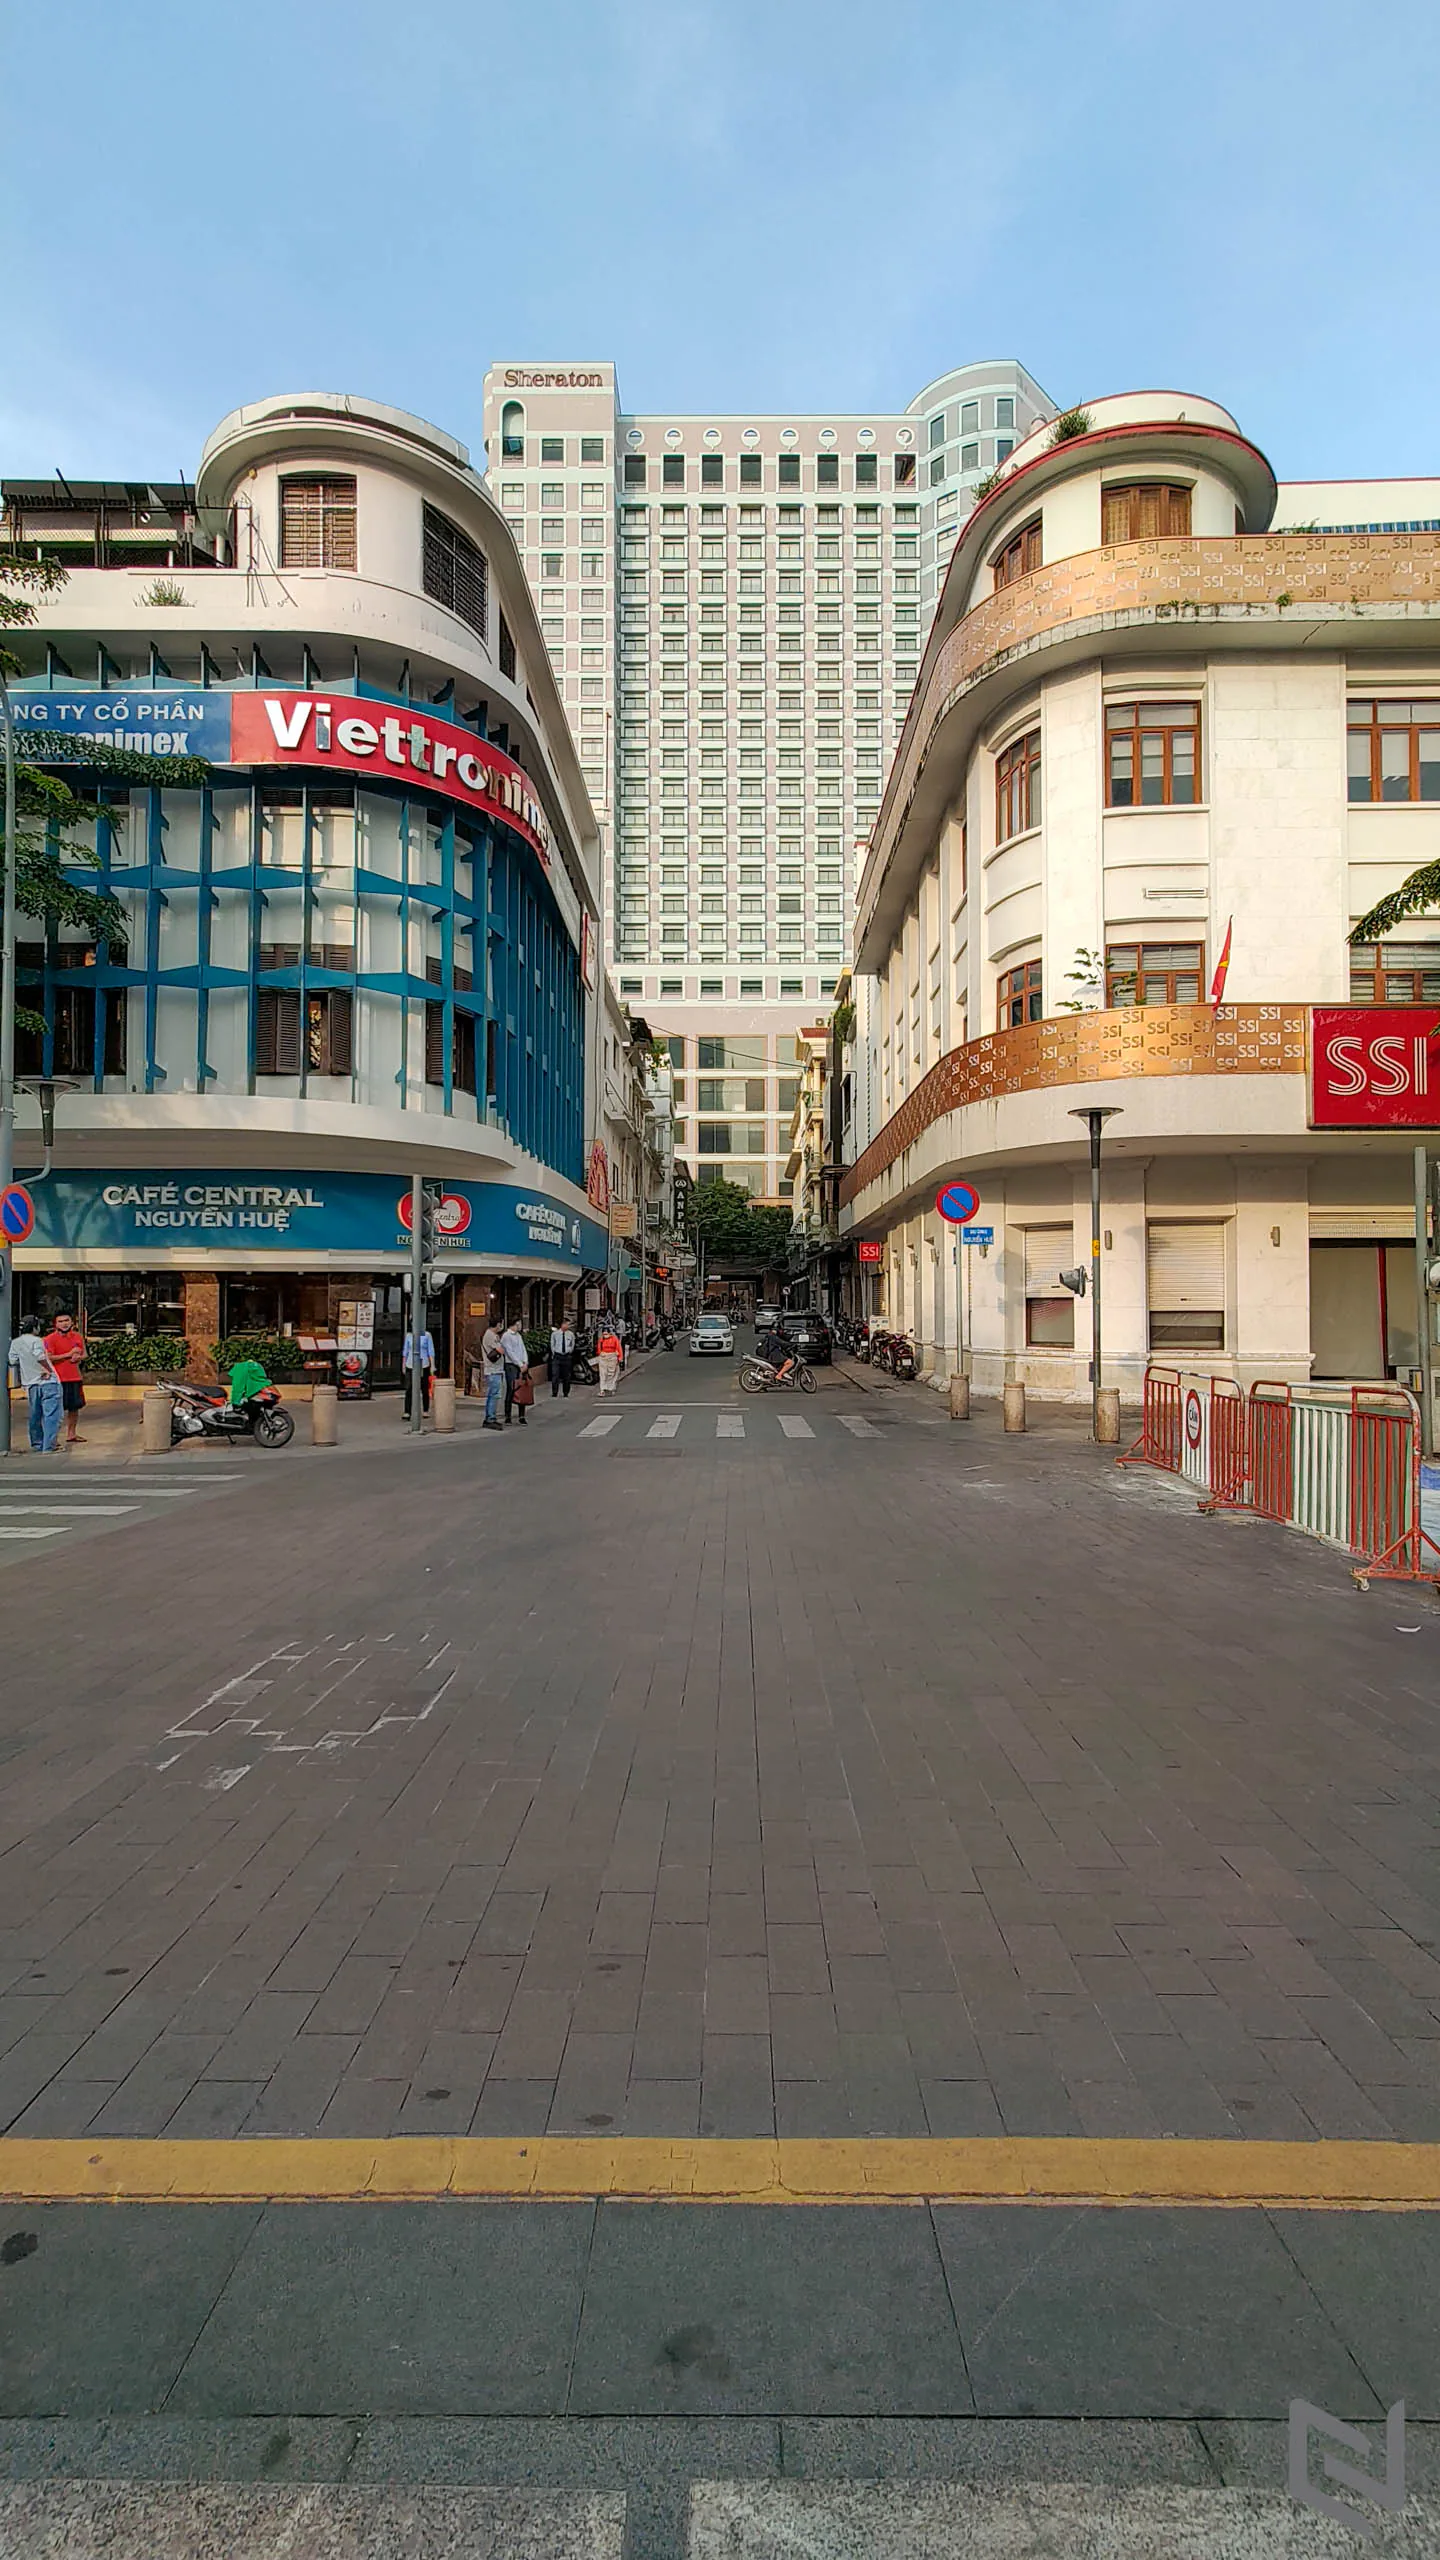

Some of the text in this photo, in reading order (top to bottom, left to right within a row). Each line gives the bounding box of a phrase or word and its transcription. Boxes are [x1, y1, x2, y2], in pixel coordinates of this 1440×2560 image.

[504, 369, 603, 387] Sheraton
[1306, 539, 1326, 550] SSI
[1350, 538, 1370, 549] SSI
[1392, 537, 1413, 549] SSI
[1224, 564, 1243, 575] SSI
[1265, 563, 1285, 575] SSI
[1306, 562, 1327, 575] SSI
[1203, 576, 1223, 588] SSI
[1244, 575, 1264, 587] SSI
[1286, 574, 1306, 586] SSI
[56, 704, 85, 720] TY
[94, 697, 129, 721] CỔ
[137, 698, 204, 720] PHẦN
[1122, 1011, 1144, 1024] SSI
[1216, 1007, 1237, 1020] SSI
[1260, 1007, 1280, 1020] SSI
[1147, 1022, 1169, 1034] SSI
[1238, 1020, 1259, 1032] SSI
[1283, 1020, 1304, 1032] SSI
[980, 1060, 993, 1074] SSI
[1122, 1036, 1144, 1049] SSI
[1216, 1033, 1237, 1045] SSI
[1260, 1032, 1280, 1045] SSI
[1238, 1045, 1259, 1057] SSI
[1283, 1045, 1304, 1057] SSI
[1326, 1036, 1427, 1096] SSI
[102, 1182, 325, 1207] CAFÉ CENTRAL
[135, 1207, 290, 1232] NGUYỄN HUỆ
[863, 1247, 878, 1256] SSI
